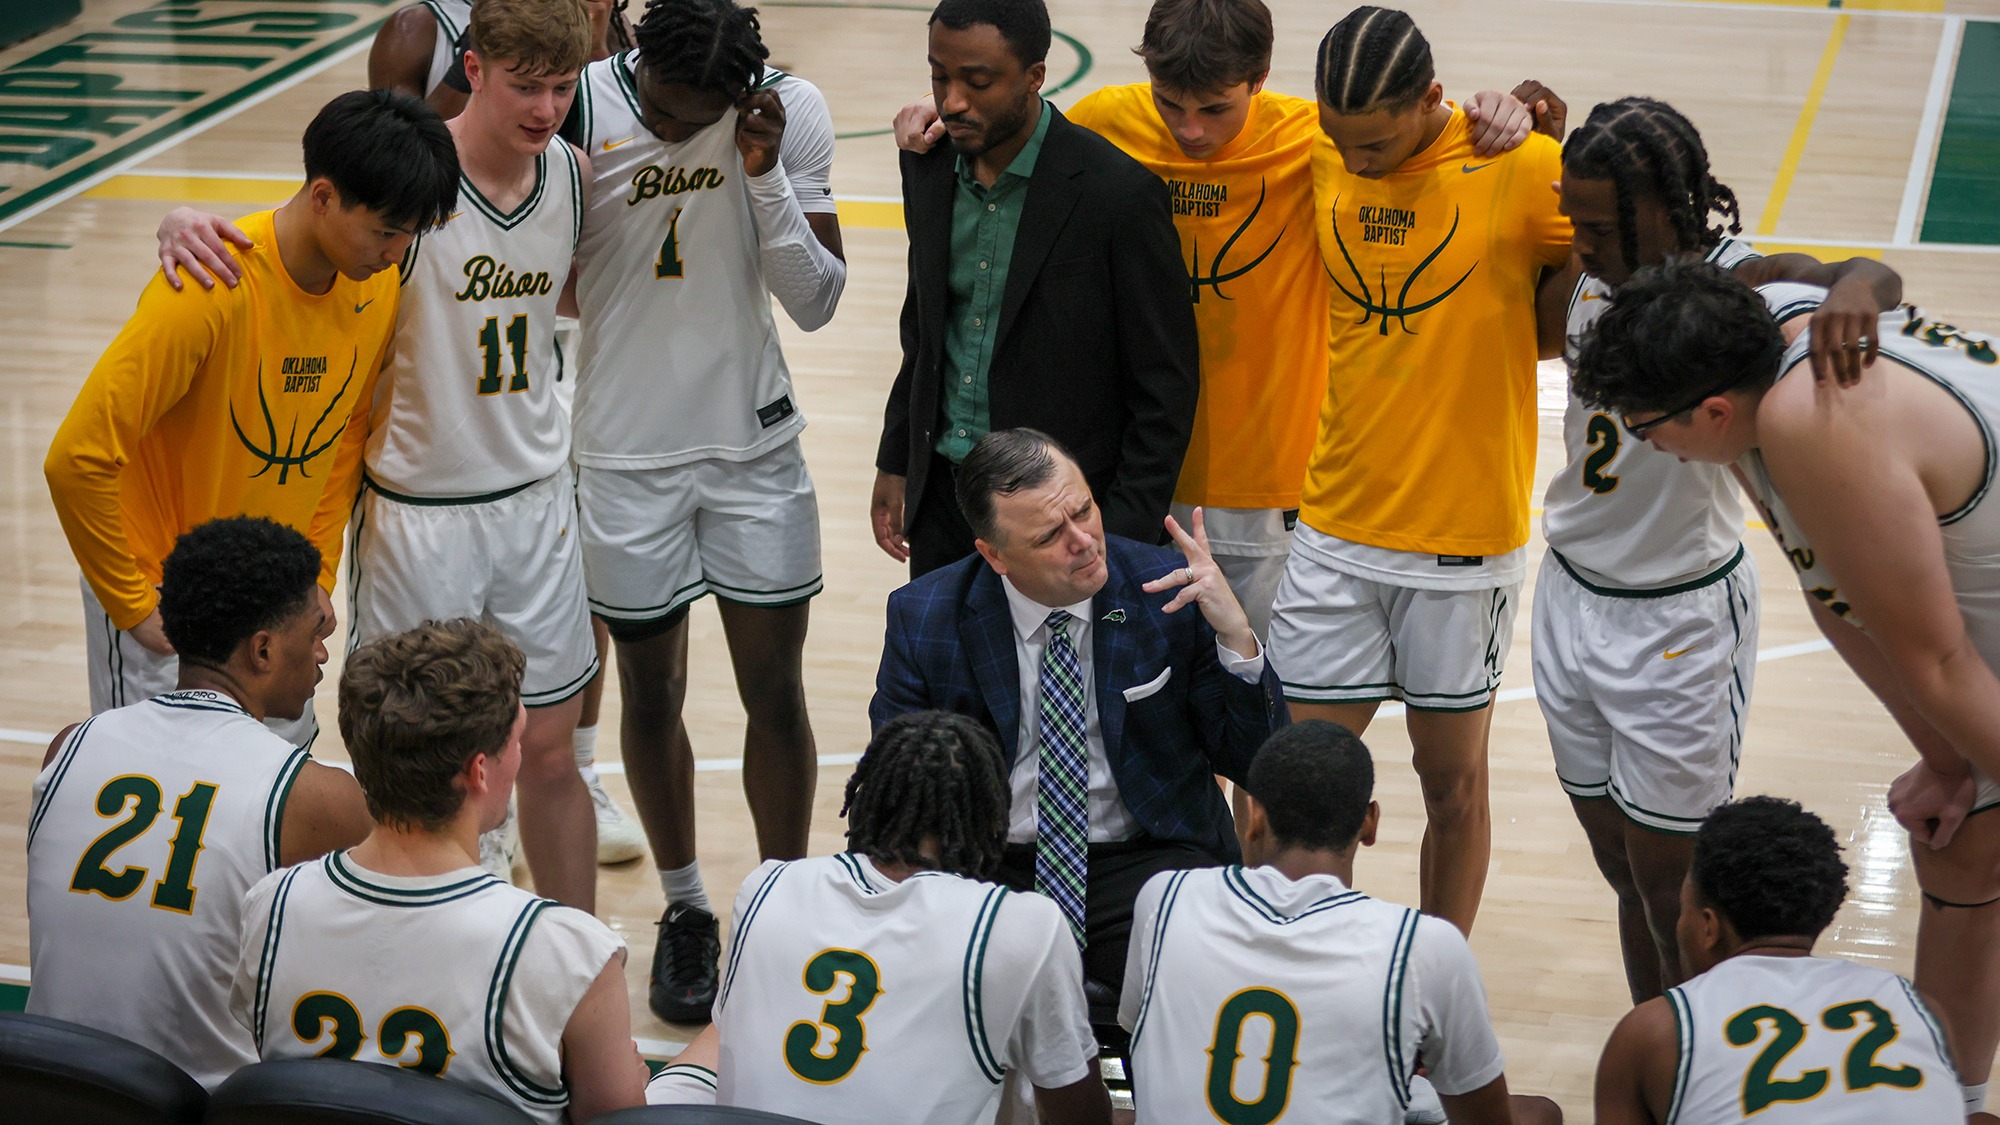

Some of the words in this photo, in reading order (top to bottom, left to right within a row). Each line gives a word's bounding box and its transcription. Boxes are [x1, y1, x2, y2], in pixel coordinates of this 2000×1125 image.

[627, 165, 725, 207] Bison
[1168, 179, 1227, 202] OKLAHOMA
[1173, 199, 1220, 217] BAPTIST
[1359, 206, 1415, 229] OKLAHOMA
[1363, 225, 1407, 246] BAPTIST
[654, 208, 684, 280] 1
[455, 254, 553, 302] Bison
[281, 356, 327, 374] OKLAHOMA
[477, 313, 530, 396] 11
[283, 376, 321, 393] BAPTIST
[1583, 412, 1623, 494] 2
[192, 691, 217, 700] PRO
[69, 772, 220, 915] 21
[783, 947, 885, 1085] 3
[1204, 986, 1301, 1125] 0
[1721, 1000, 1924, 1118] 22
